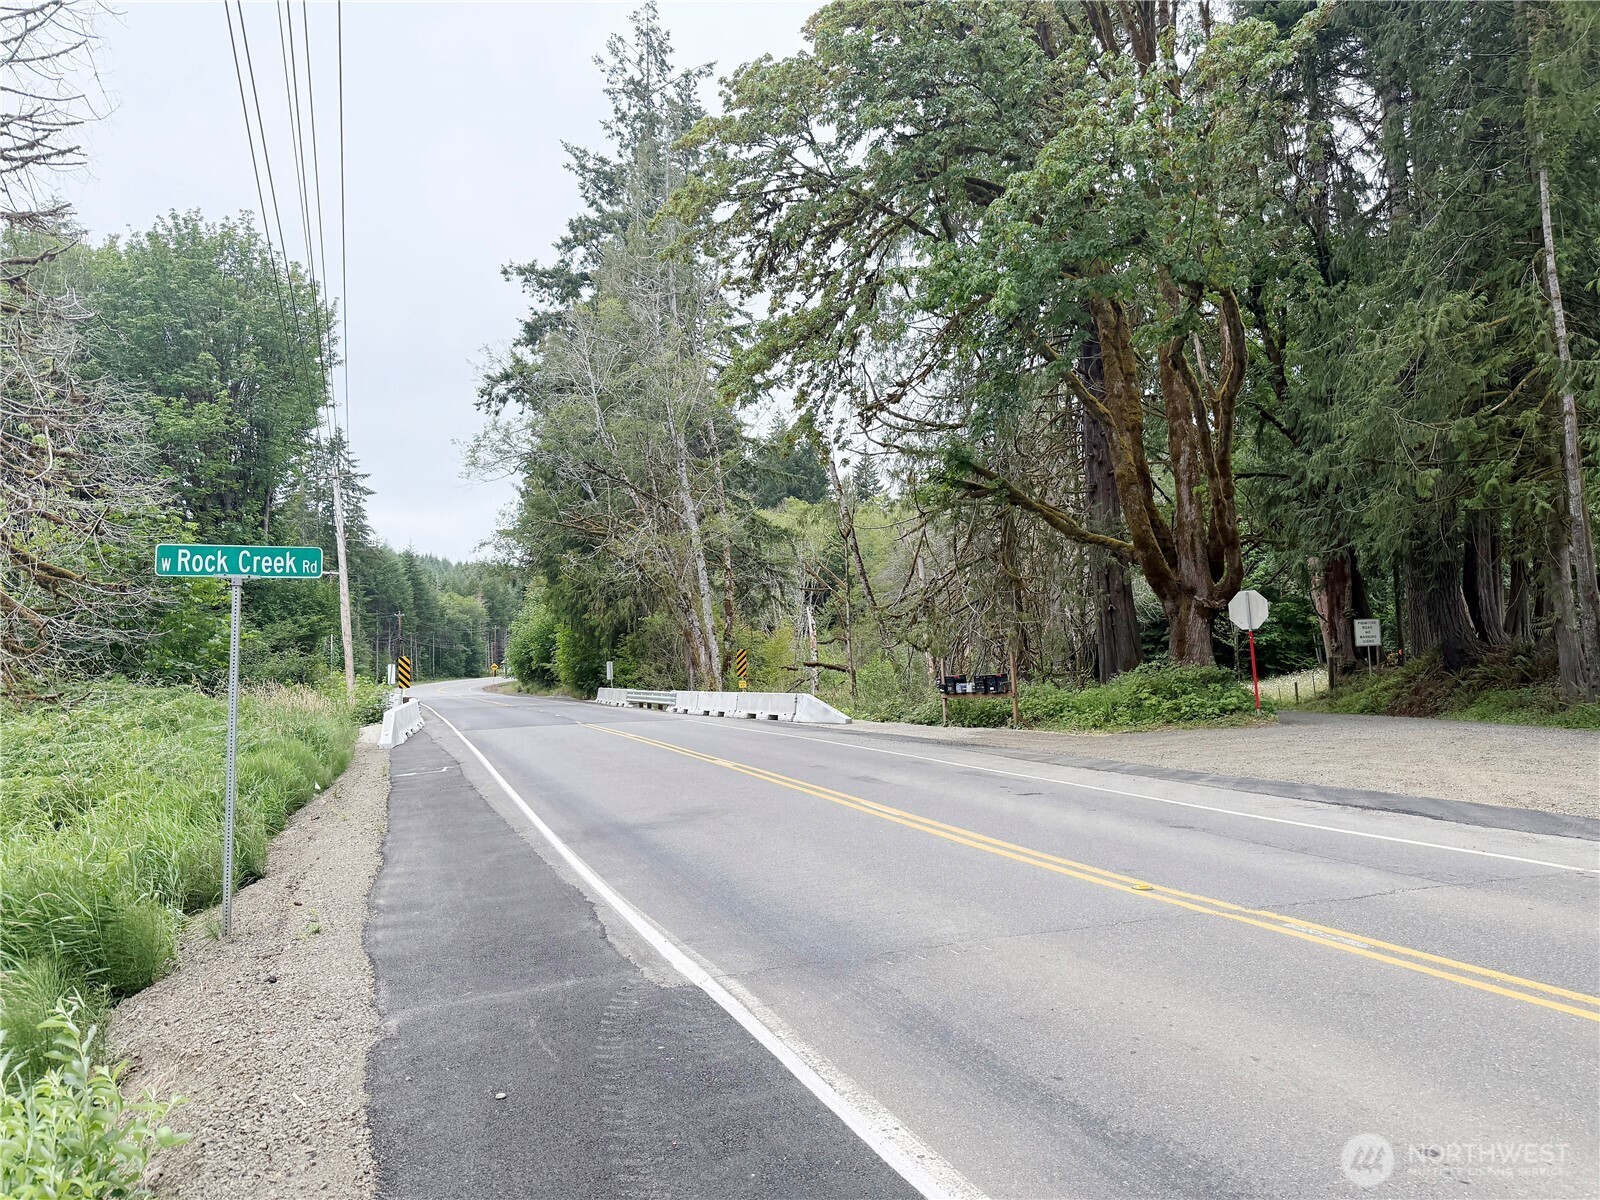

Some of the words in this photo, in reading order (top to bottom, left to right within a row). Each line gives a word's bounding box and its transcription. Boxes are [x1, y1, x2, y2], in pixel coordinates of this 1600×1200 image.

[161, 557, 172, 572] W
[177, 548, 229, 573] Rock
[238, 550, 298, 574] Creek
[302, 560, 318, 574] Rd
